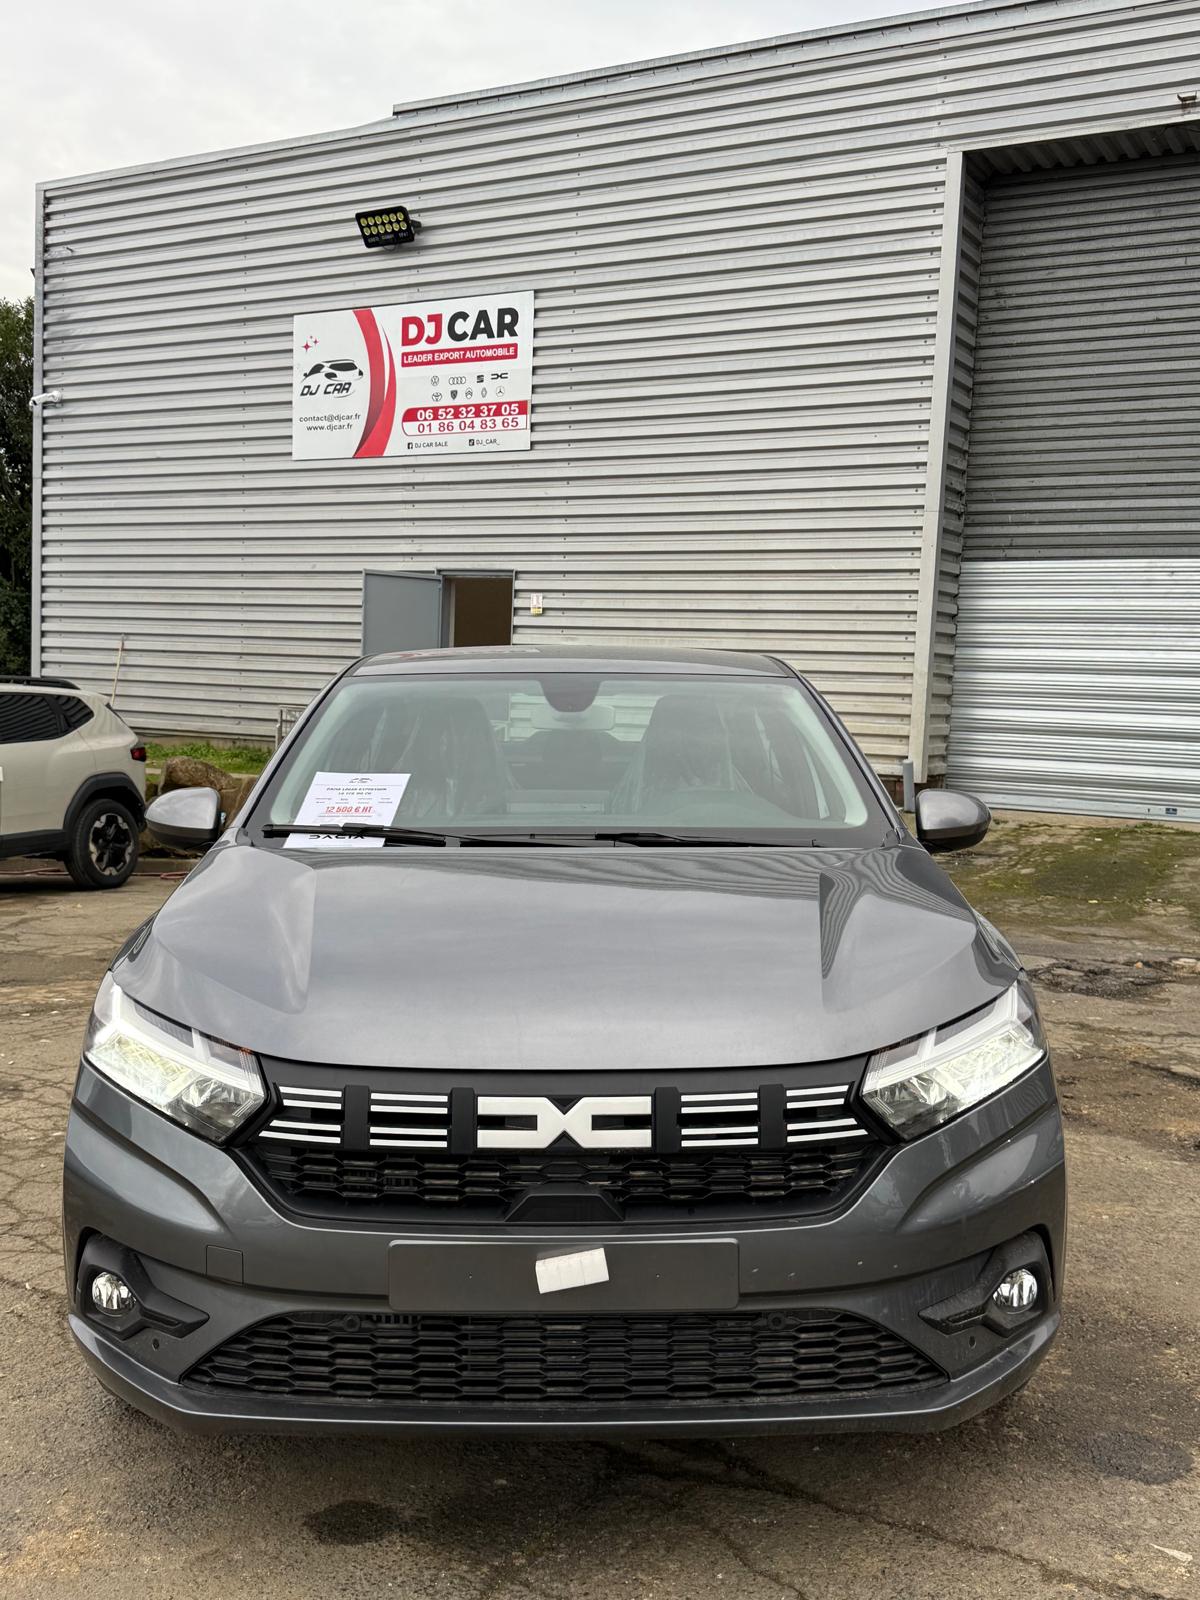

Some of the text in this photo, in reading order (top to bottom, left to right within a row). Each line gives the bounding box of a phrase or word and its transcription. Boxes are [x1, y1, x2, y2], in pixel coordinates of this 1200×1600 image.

[401, 307, 519, 347] DJ CAR
[403, 347, 515, 364] LEADER EXPORT AUTOMOBILE
[300, 382, 352, 397] DJ CAR
[299, 413, 361, 423] contact@djcar.fr
[417, 403, 519, 421] 06 52 32 37 05
[306, 423, 352, 431] www.djcar.fr
[417, 417, 519, 433] 01 86 04 83 65
